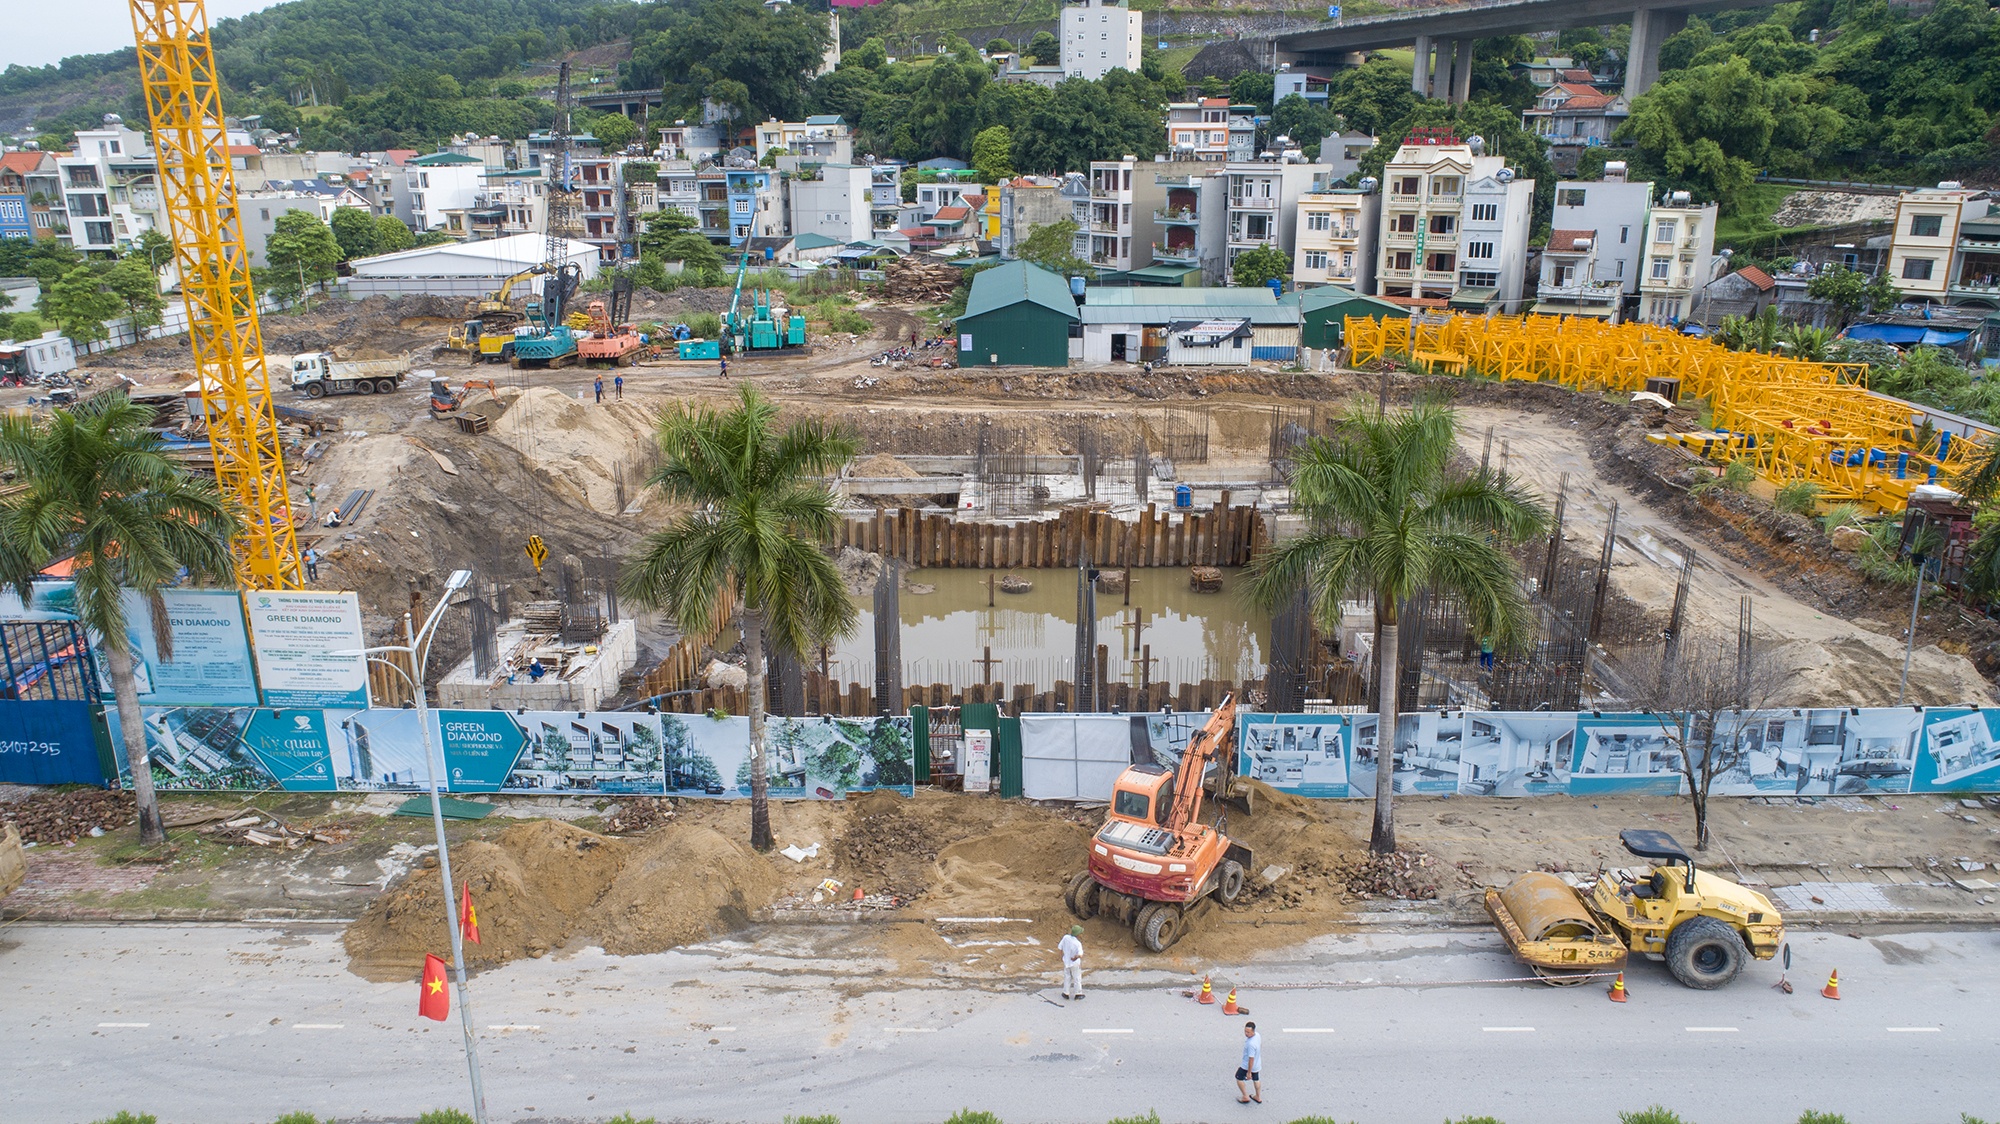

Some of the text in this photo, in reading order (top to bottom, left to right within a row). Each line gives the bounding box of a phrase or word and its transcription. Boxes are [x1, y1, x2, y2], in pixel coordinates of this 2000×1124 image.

[446, 722, 485, 732] GREEN
[447, 732, 502, 742] DIAMOND
[284, 739, 322, 752] quan
